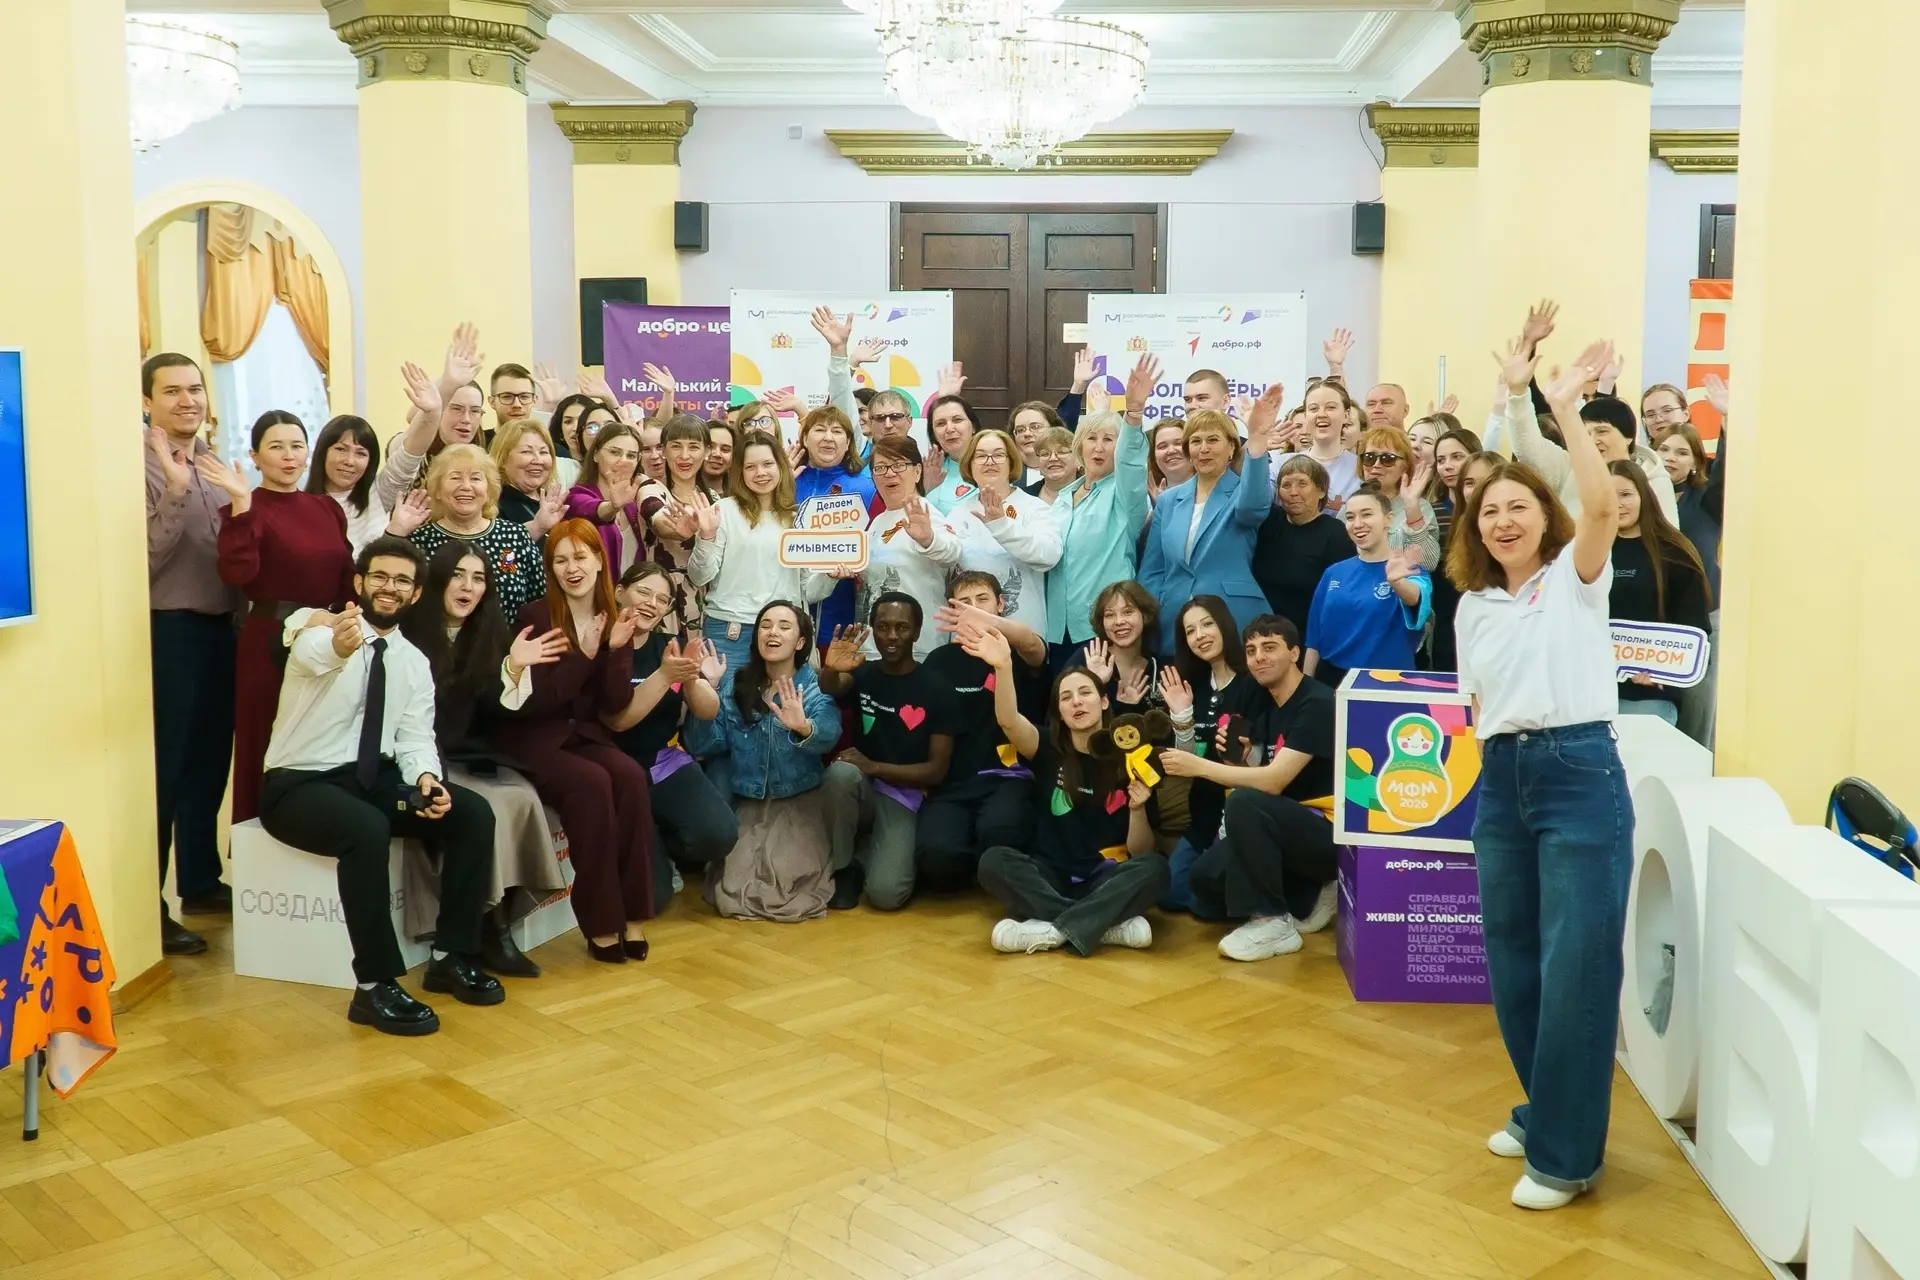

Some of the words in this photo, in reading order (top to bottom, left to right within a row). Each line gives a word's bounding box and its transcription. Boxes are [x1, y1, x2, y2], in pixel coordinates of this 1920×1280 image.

[1212, 340, 1262, 349] добро.рф
[817, 499, 853, 512] Делаем
[811, 509, 860, 529] ДОБРО
[788, 543, 858, 553] #МЫВМЕСТЕ
[1655, 638, 1694, 650] сердце
[1387, 780, 1438, 796] МФМ
[1399, 798, 1429, 809] 2026
[1385, 860, 1444, 871] добро.рф
[1408, 904, 1458, 913] ЧЕСТНО
[1366, 913, 1405, 922] ЖИВИ
[1407, 913, 1425, 922] СО
[1407, 935, 1455, 945] ЩЕДРО
[1407, 964, 1445, 973] ЛЮБЯ
[1407, 974, 1486, 984] ОСОЗНАННО
